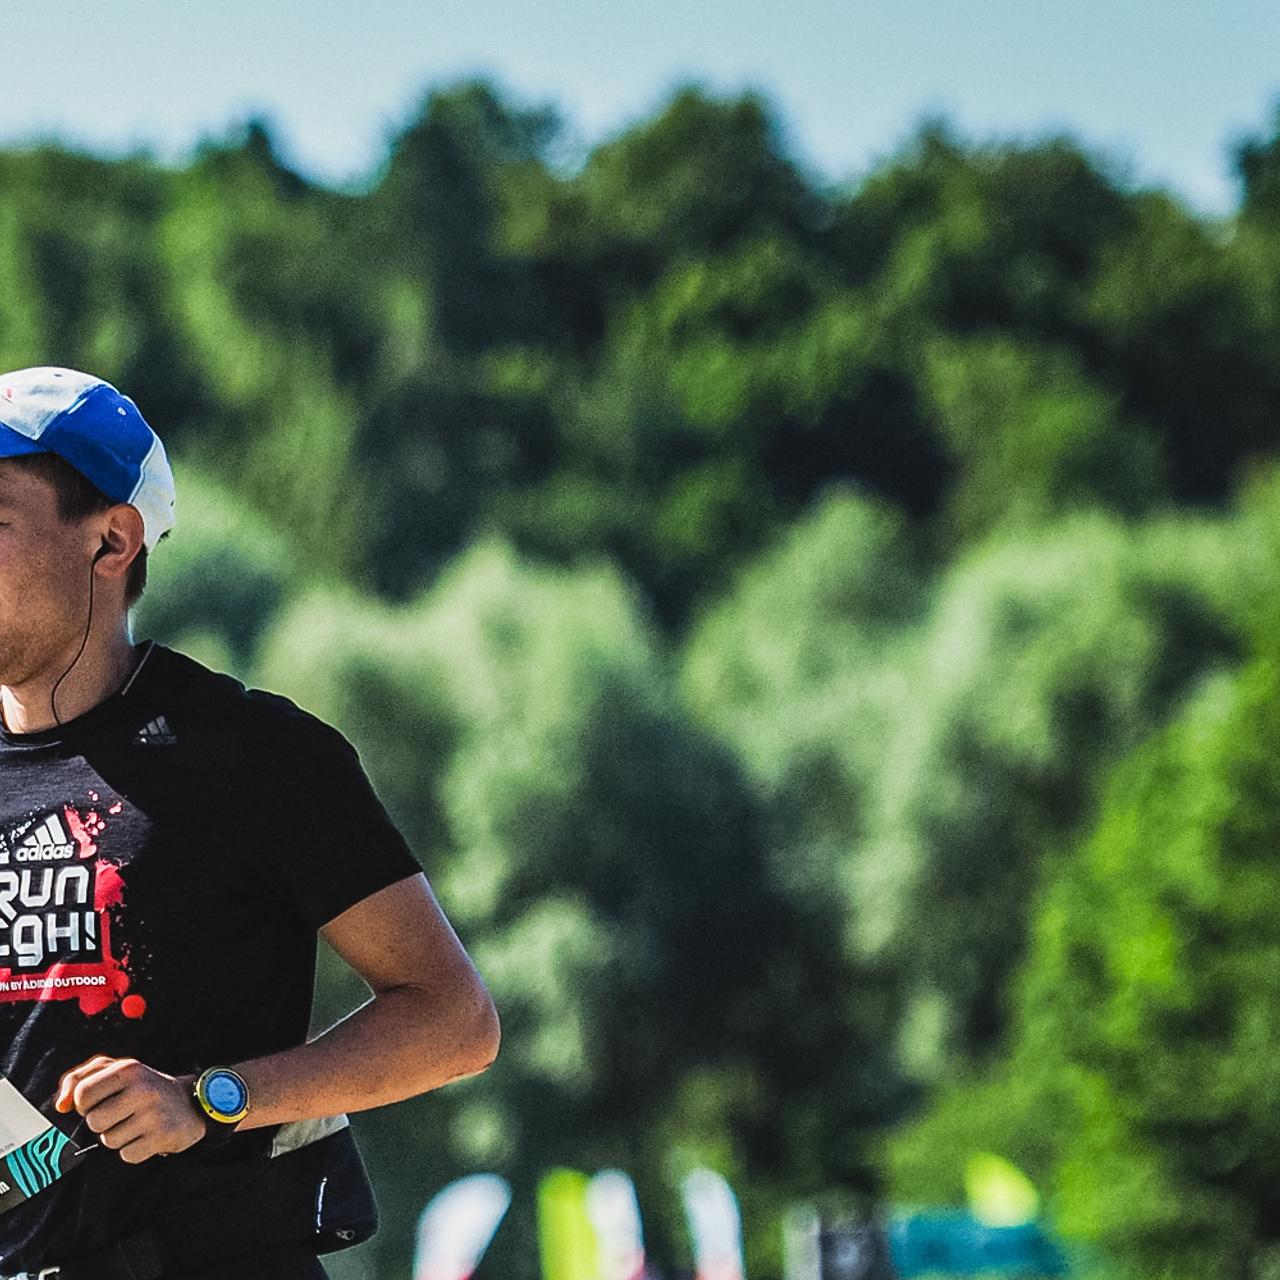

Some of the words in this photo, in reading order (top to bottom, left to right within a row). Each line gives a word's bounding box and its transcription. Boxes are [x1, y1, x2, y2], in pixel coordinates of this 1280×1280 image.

[16, 843, 73, 861] adidas
[11, 980, 23, 991] BY
[54, 976, 107, 988] OUTDOOR
